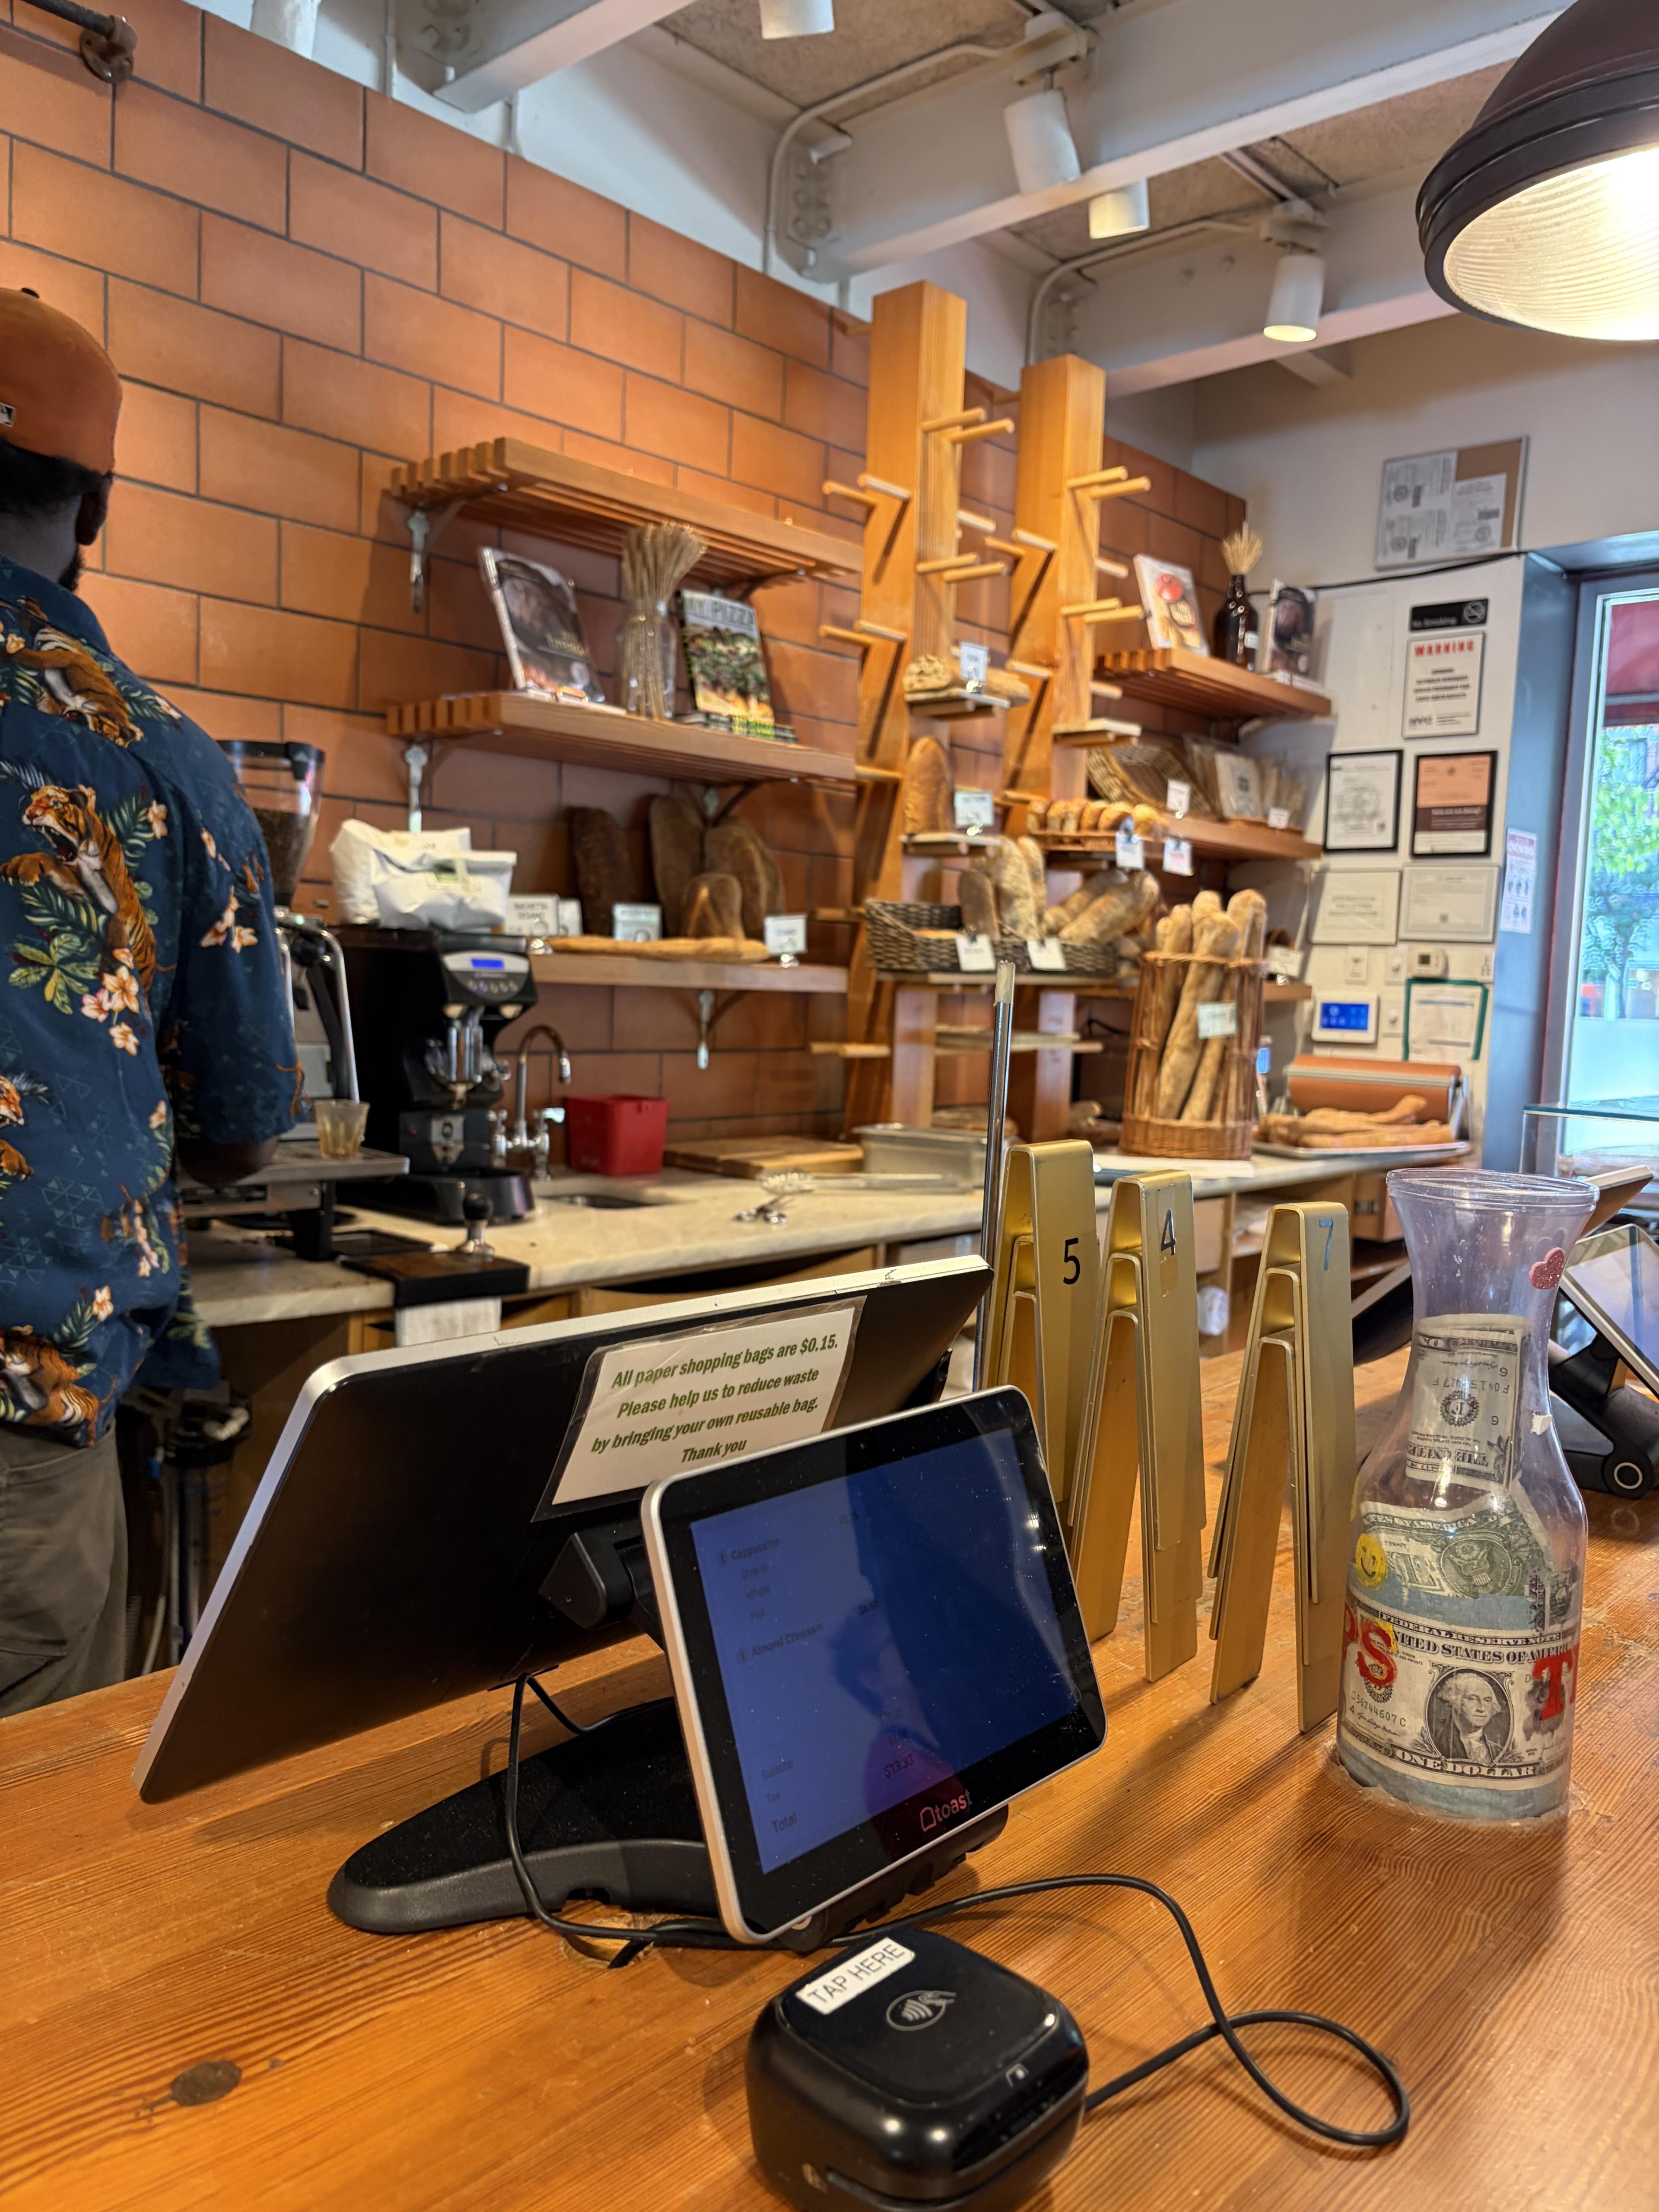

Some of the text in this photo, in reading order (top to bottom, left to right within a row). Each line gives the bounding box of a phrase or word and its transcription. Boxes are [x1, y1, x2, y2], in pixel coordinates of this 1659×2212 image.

[1414, 639, 1475, 657] WARNING
[1160, 1209, 1177, 1256] 4
[1319, 1219, 1334, 1271] 7
[1063, 1237, 1081, 1285] 5
[611, 1334, 838, 1389] All paper shopping bags are $0.15.
[617, 1368, 819, 1418] Please help us to reduce waste
[591, 1397, 818, 1455] by bringing your own reusable bag.
[681, 1438, 747, 1464] Thank you
[1411, 1517, 1478, 1530] AMERICA
[1381, 1613, 1454, 1638] FEDERAL
[1456, 1633, 1528, 1645] RESERVE
[752, 1636, 784, 1658] Almond
[1393, 1630, 1440, 1654] NITED
[1441, 1643, 1504, 1663] STATES
[1506, 1650, 1528, 1665] OF
[761, 1758, 794, 1780] Subtotal
[1396, 1749, 1534, 1777] ONE DOLLAR
[766, 1792, 781, 1804] Tax
[934, 1789, 973, 1822] toast
[772, 1811, 798, 1833] Total
[807, 1944, 906, 2002] TAP HERE
